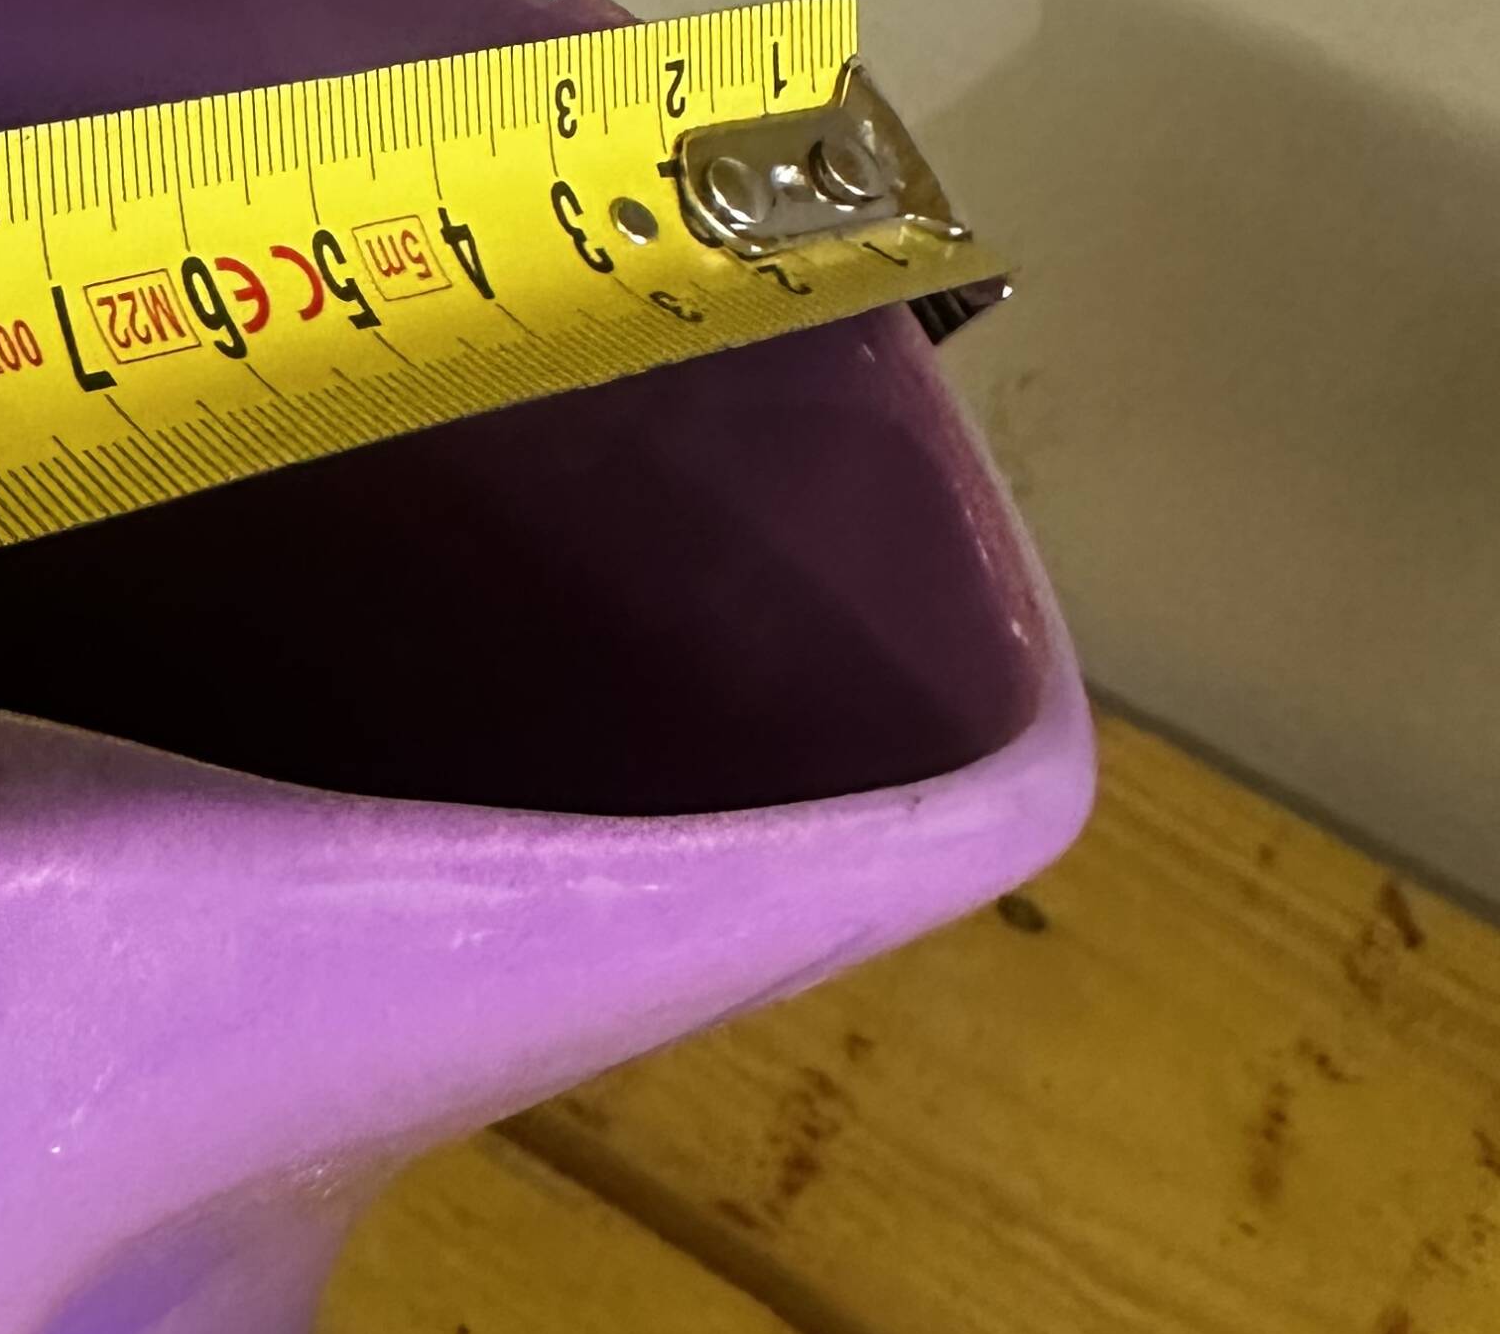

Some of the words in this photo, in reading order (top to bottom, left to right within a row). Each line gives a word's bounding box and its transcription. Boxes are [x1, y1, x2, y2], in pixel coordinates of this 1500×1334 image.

[664, 58, 687, 119] 2
[773, 41, 788, 99] 1
[554, 78, 578, 140] 3
[366, 229, 434, 282] 5m
[437, 207, 495, 300] 4
[551, 180, 614, 274] 3
[180, 255, 248, 360] 6
[311, 229, 383, 331] 5
[648, 289, 704, 323] 3
[51, 284, 118, 394] 7
[96, 283, 188, 350] M22
